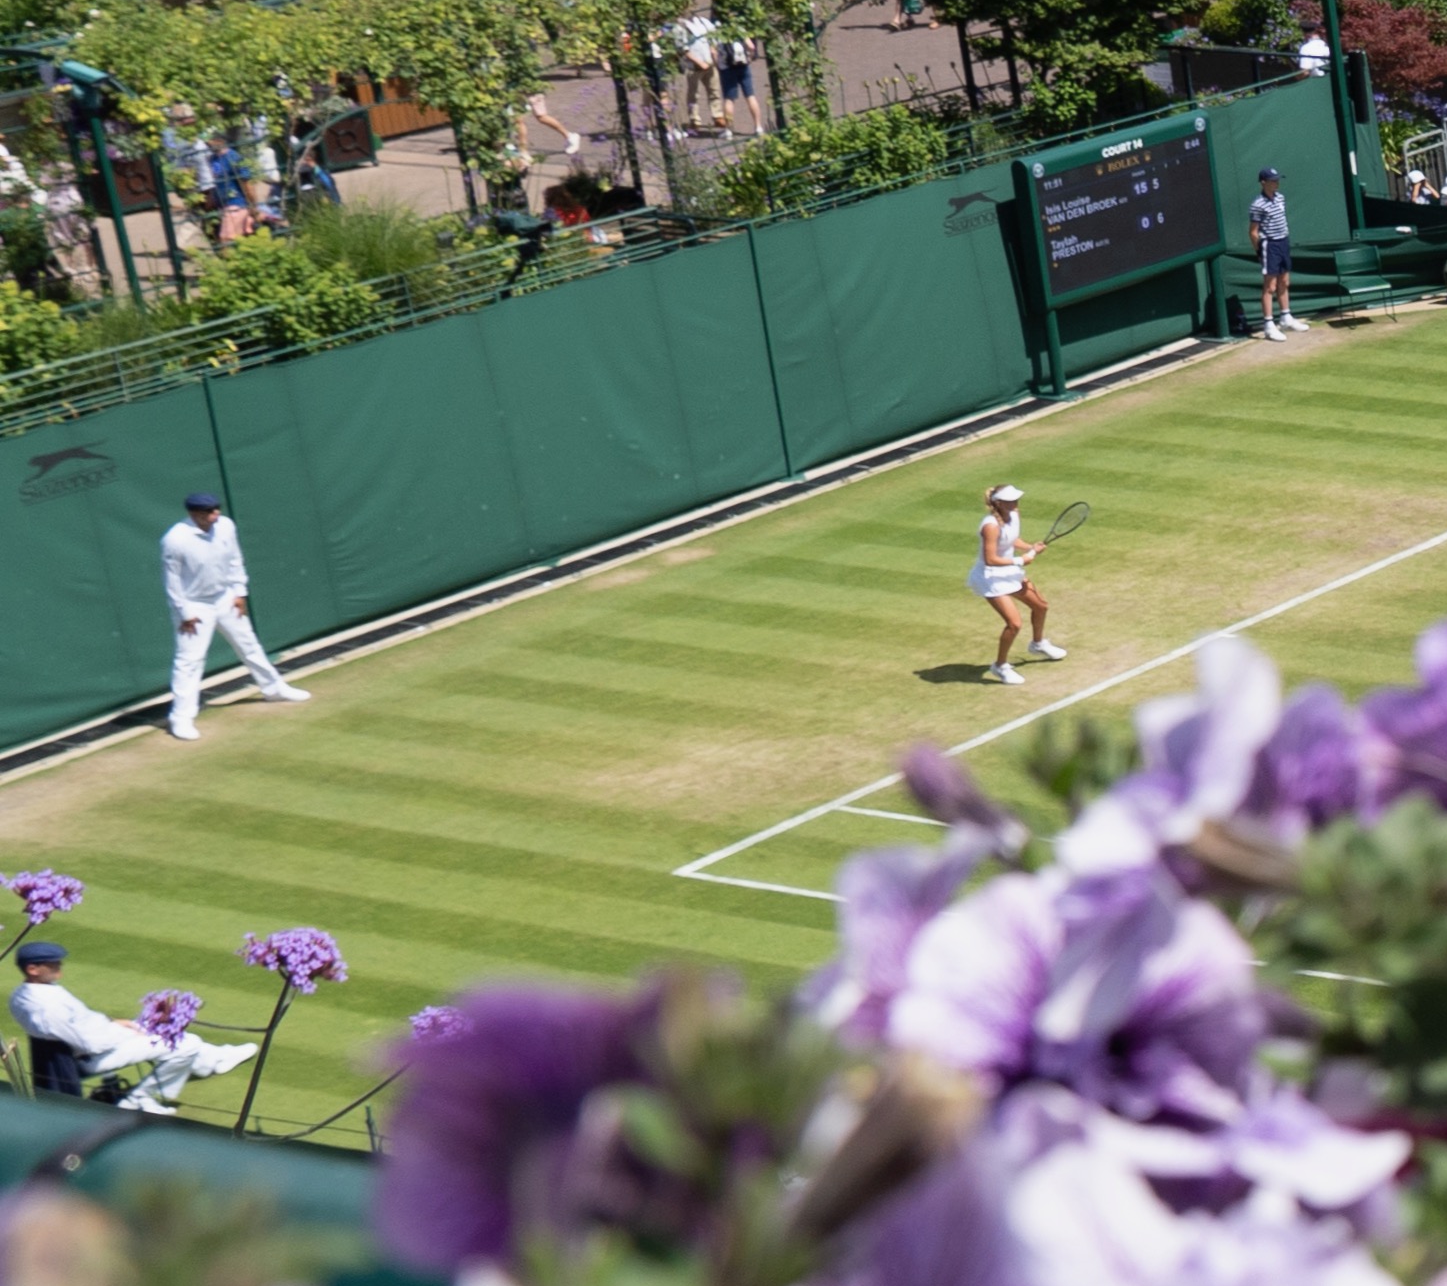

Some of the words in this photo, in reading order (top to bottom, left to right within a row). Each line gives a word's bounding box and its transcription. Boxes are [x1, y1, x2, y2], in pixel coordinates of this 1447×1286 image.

[1102, 141, 1132, 158] COURT
[1133, 138, 1143, 150] 14
[1107, 155, 1140, 172] ROLEX
[1133, 181, 1148, 195] 15
[1152, 178, 1160, 190] 5
[1046, 211, 1066, 225] VAN
[1066, 206, 1086, 220] DEN
[1140, 216, 1150, 229] 0
[1156, 212, 1165, 224] 6
[1051, 239, 1095, 262] PRESTON
